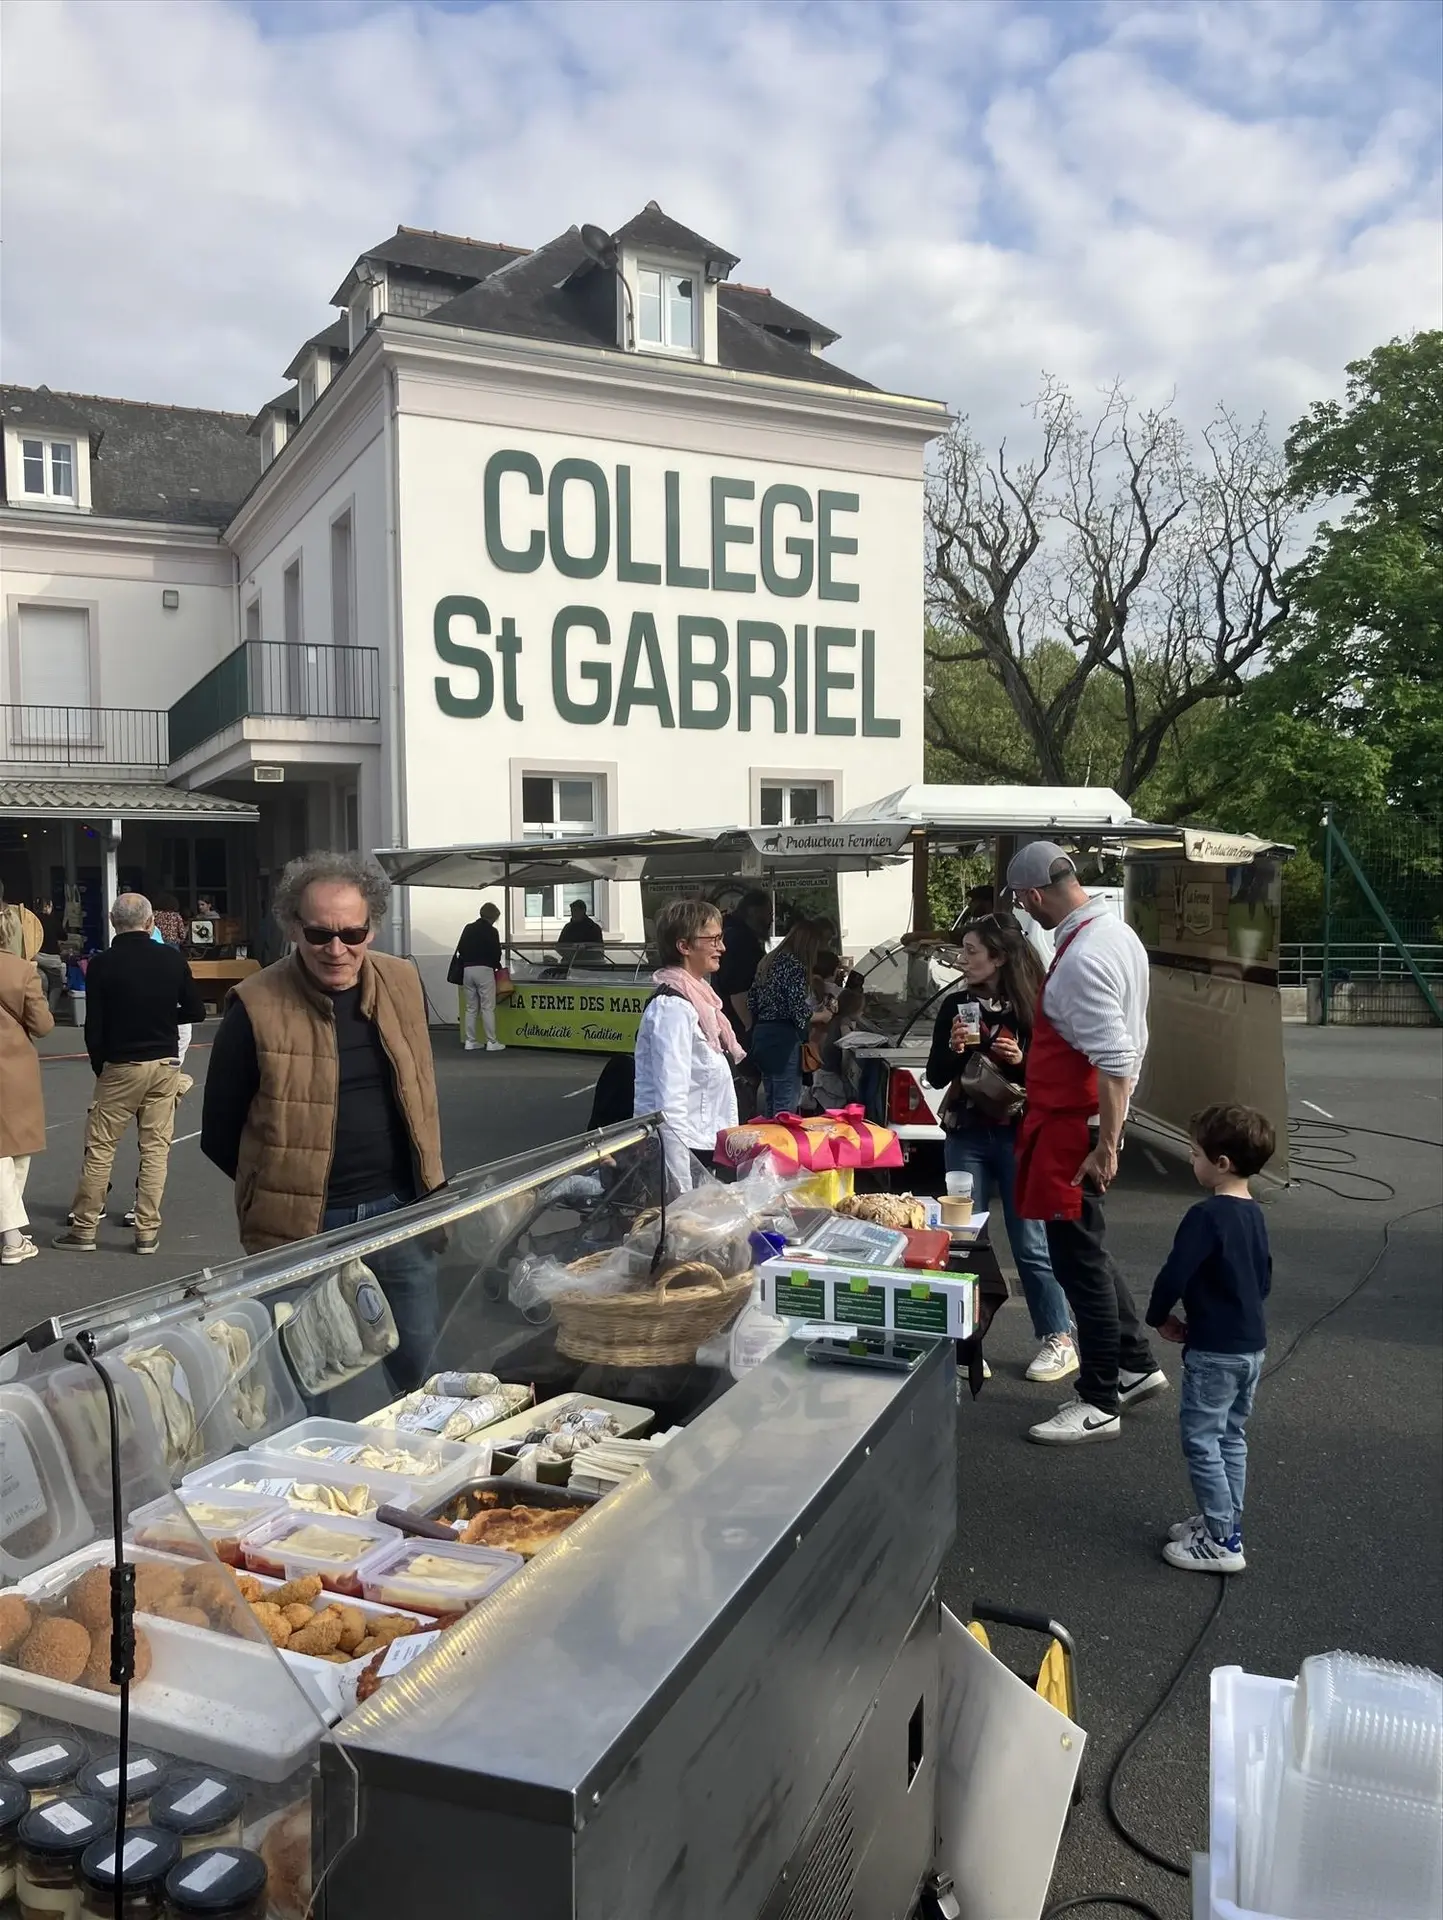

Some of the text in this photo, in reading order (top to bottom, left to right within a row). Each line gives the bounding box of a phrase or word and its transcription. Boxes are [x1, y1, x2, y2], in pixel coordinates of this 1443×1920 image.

[483, 448, 860, 603] COLLEGE
[433, 594, 901, 738] St GABRIEL
[785, 833, 893, 849] Producteur Fermier
[509, 995, 525, 1009] LA
[531, 995, 575, 1011] FERME
[580, 996, 605, 1012] DES
[516, 1023, 573, 1039] Authenticité
[581, 1024, 623, 1041] Tradition
